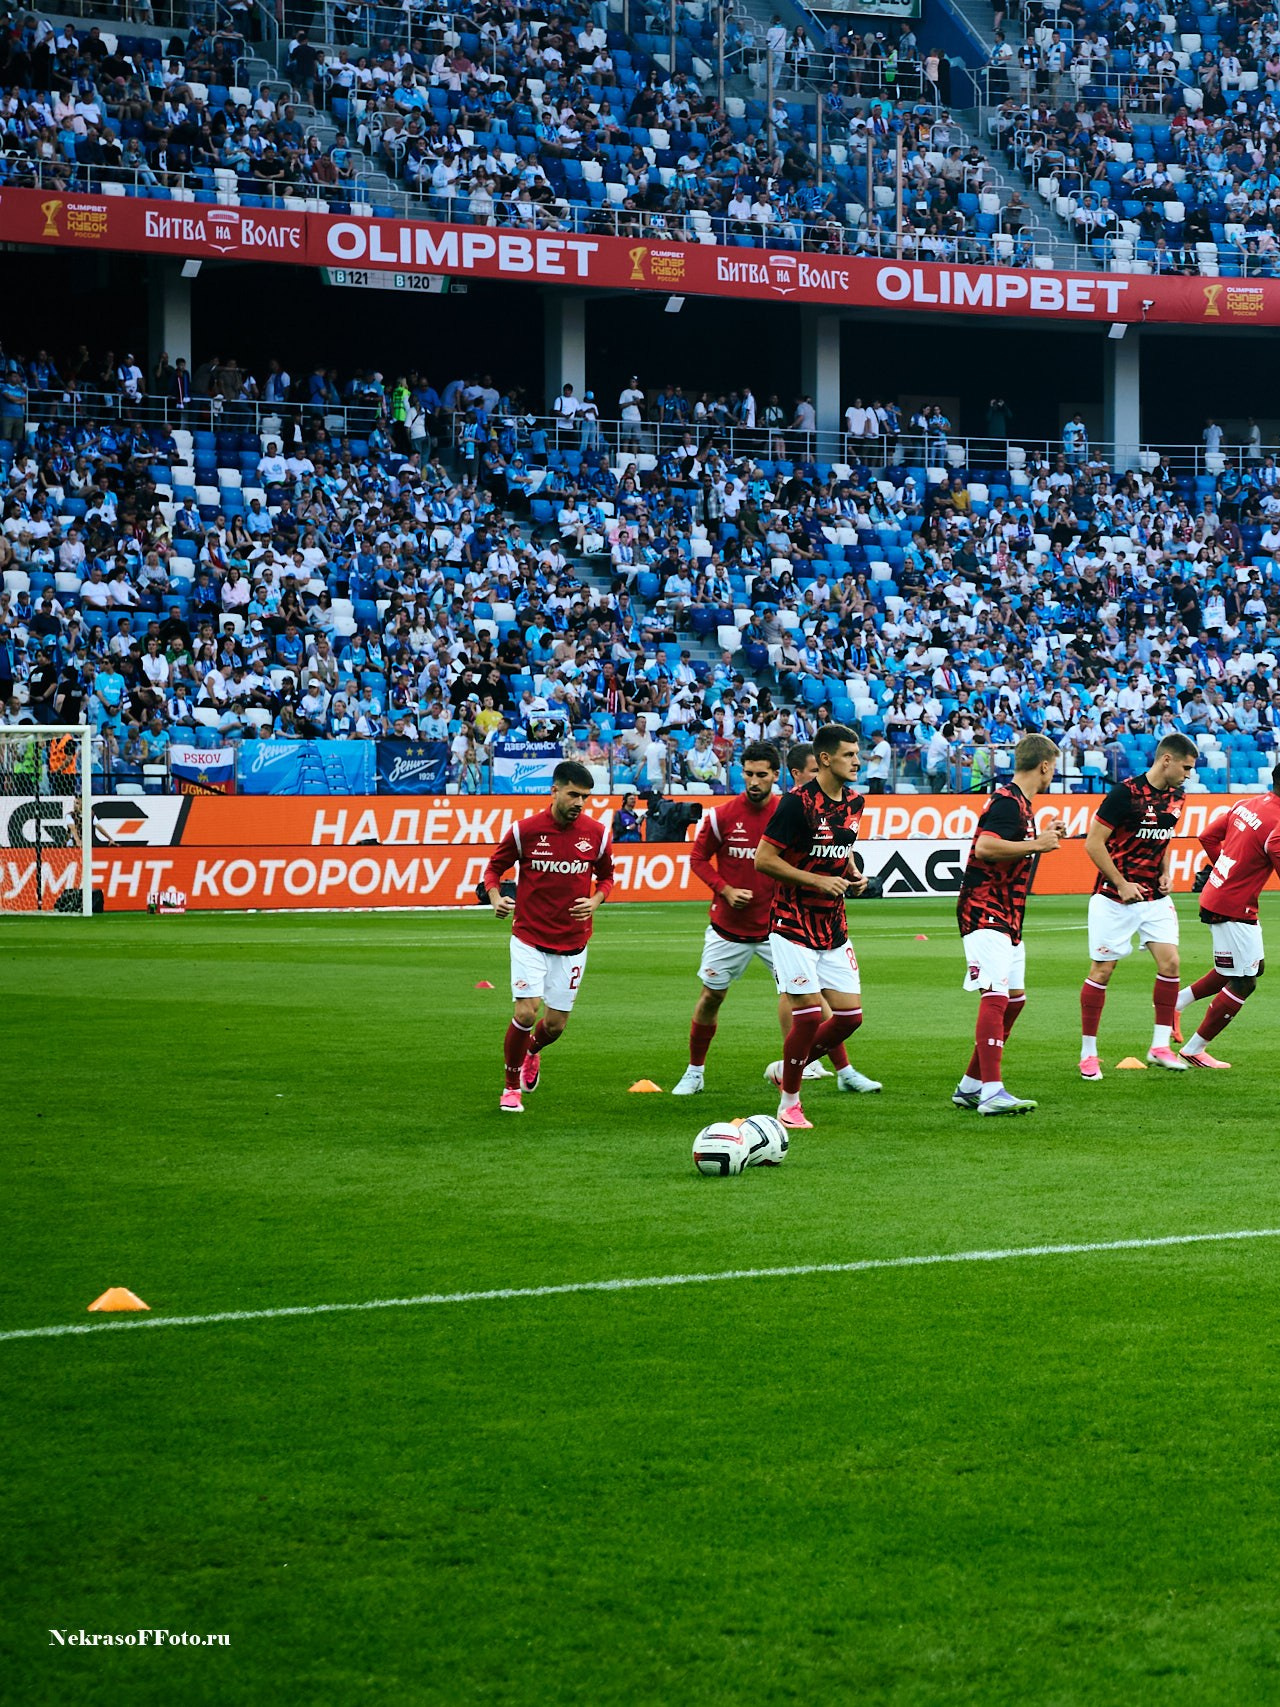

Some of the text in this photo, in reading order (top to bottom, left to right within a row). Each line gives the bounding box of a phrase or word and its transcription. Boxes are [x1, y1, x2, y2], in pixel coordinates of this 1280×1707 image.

[67, 203, 107, 212] OLIMPBET
[326, 222, 599, 277] OLIMPBET
[650, 250, 685, 258] OLIMPBET
[348, 271, 369, 285] 121
[408, 276, 430, 289] 120
[876, 266, 1129, 313] OLIMPBET
[504, 741, 557, 752] ДЗЕРЖИНСК
[184, 753, 221, 763] PSKOV
[728, 847, 758, 861] ЛУК
[809, 843, 851, 859] ЛУКОЙ
[531, 859, 589, 874] ЛУКОЙЛ
[192, 858, 451, 896] КОТОРОМУ
